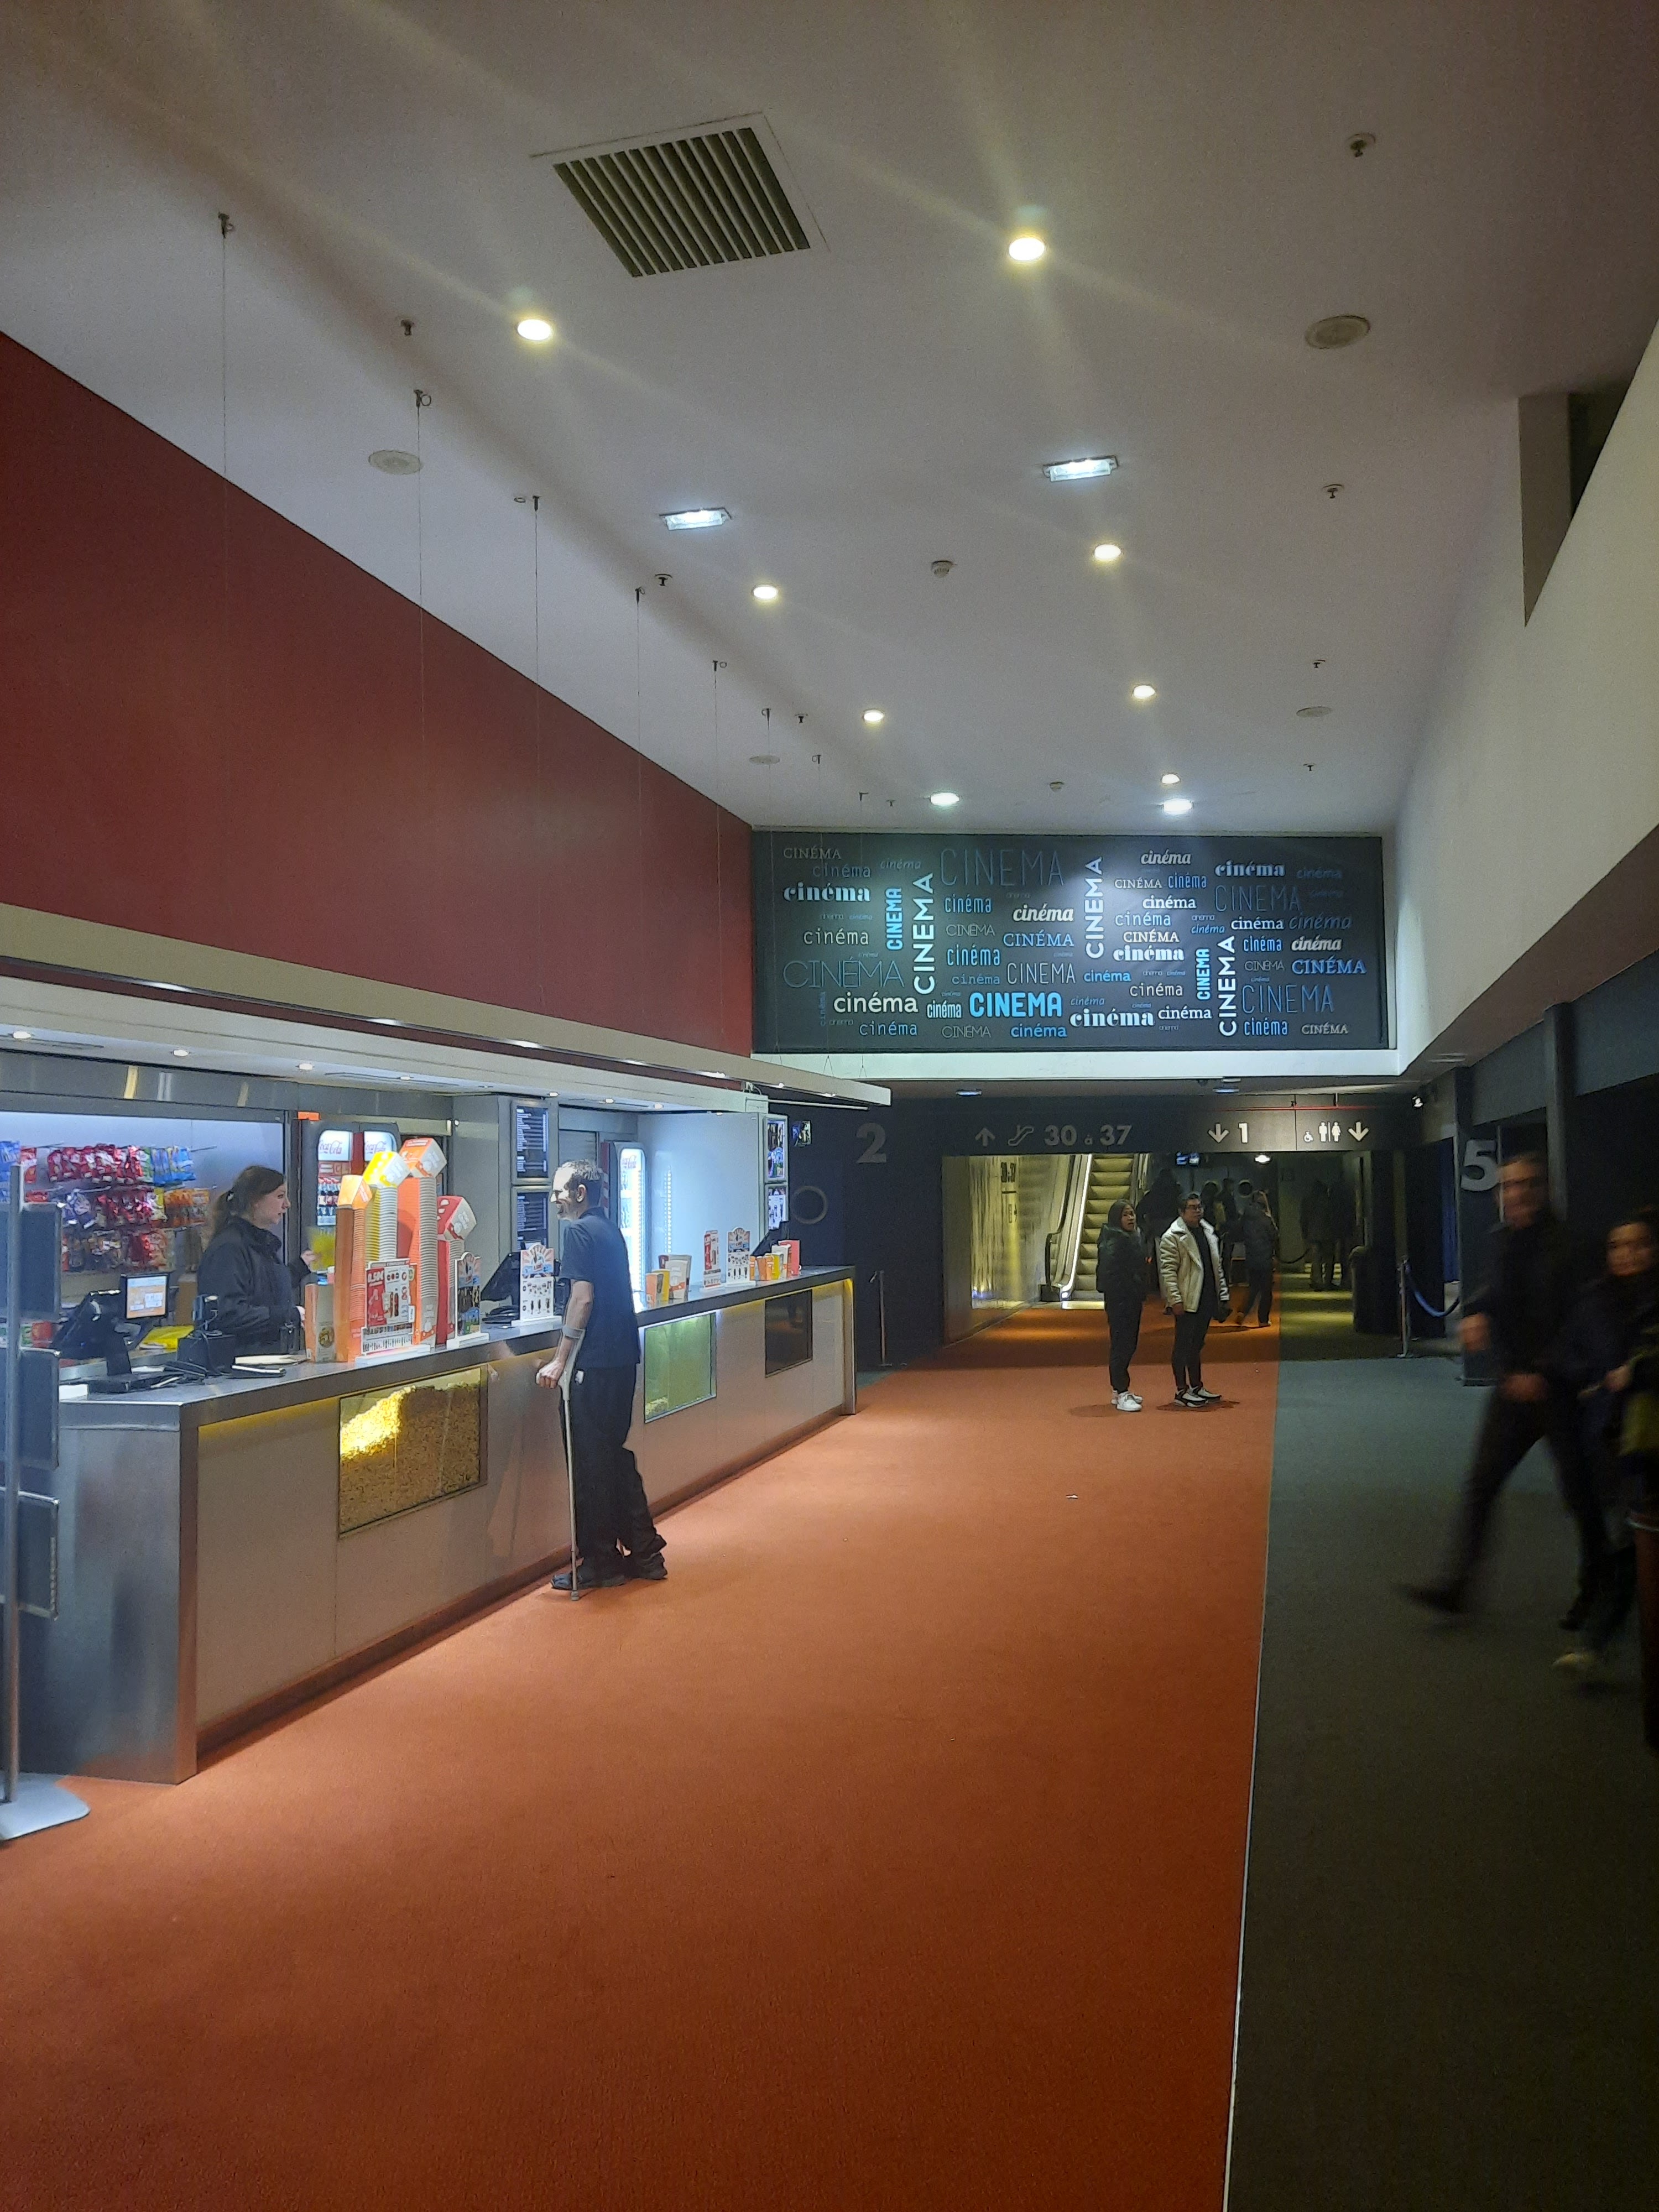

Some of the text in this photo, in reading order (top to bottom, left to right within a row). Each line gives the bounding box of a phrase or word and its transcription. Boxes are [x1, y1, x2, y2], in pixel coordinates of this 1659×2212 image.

[1141, 849, 1191, 864] cinéma
[941, 849, 1063, 885] CINEMA
[1215, 860, 1286, 877] cinéma
[1115, 877, 1162, 889] CINÉMA
[1168, 872, 1207, 889] cinéma
[783, 881, 871, 901] cinéma
[1215, 885, 1301, 911] CINEMA
[945, 894, 992, 913] cinéma
[1084, 857, 1104, 958] CINEMA
[1142, 895, 1196, 909] cinéma
[885, 887, 903, 950] CINEMA
[1013, 902, 1074, 921] cinéma
[1115, 911, 1171, 926] cinéma
[1231, 916, 1284, 930] cinéma
[1289, 912, 1352, 930] cinéma
[804, 927, 869, 945] cinéma
[912, 872, 935, 994] CINEMA
[1003, 930, 1074, 947] CINÉMA
[1123, 929, 1180, 942] CINÉMA
[1244, 935, 1283, 952] cinéma
[1291, 935, 1343, 951] cinéma
[947, 943, 1000, 966] cinéma
[1113, 945, 1185, 961] cinéma
[783, 956, 905, 988] CINÉMA
[1007, 962, 1076, 984] CINEMA
[1292, 955, 1367, 974] CINÉMA
[952, 974, 1000, 984] cinéma
[1084, 969, 1131, 982] cinéma
[1196, 948, 1212, 1000] CINEMA
[1130, 983, 1183, 997] cinéma
[1217, 936, 1237, 1036] CINEMA
[833, 992, 919, 1013] cinéma
[969, 992, 1062, 1017] CINEMA
[1242, 985, 1335, 1013] CINEMA
[927, 1000, 962, 1018] cinéma
[1070, 1008, 1155, 1027] cinéma
[1158, 1005, 1212, 1019] cinéma
[859, 1021, 917, 1035] cinéma
[1010, 1023, 1067, 1038] cinéma
[1244, 1018, 1288, 1035] cinéma
[1301, 1022, 1348, 1035] CINÉMA
[1044, 1125, 1077, 1146] 30
[1100, 1125, 1132, 1146] 37
[1238, 1123, 1248, 1143] 1
[856, 1123, 886, 1163] 2
[1460, 1138, 1499, 1192] 5
